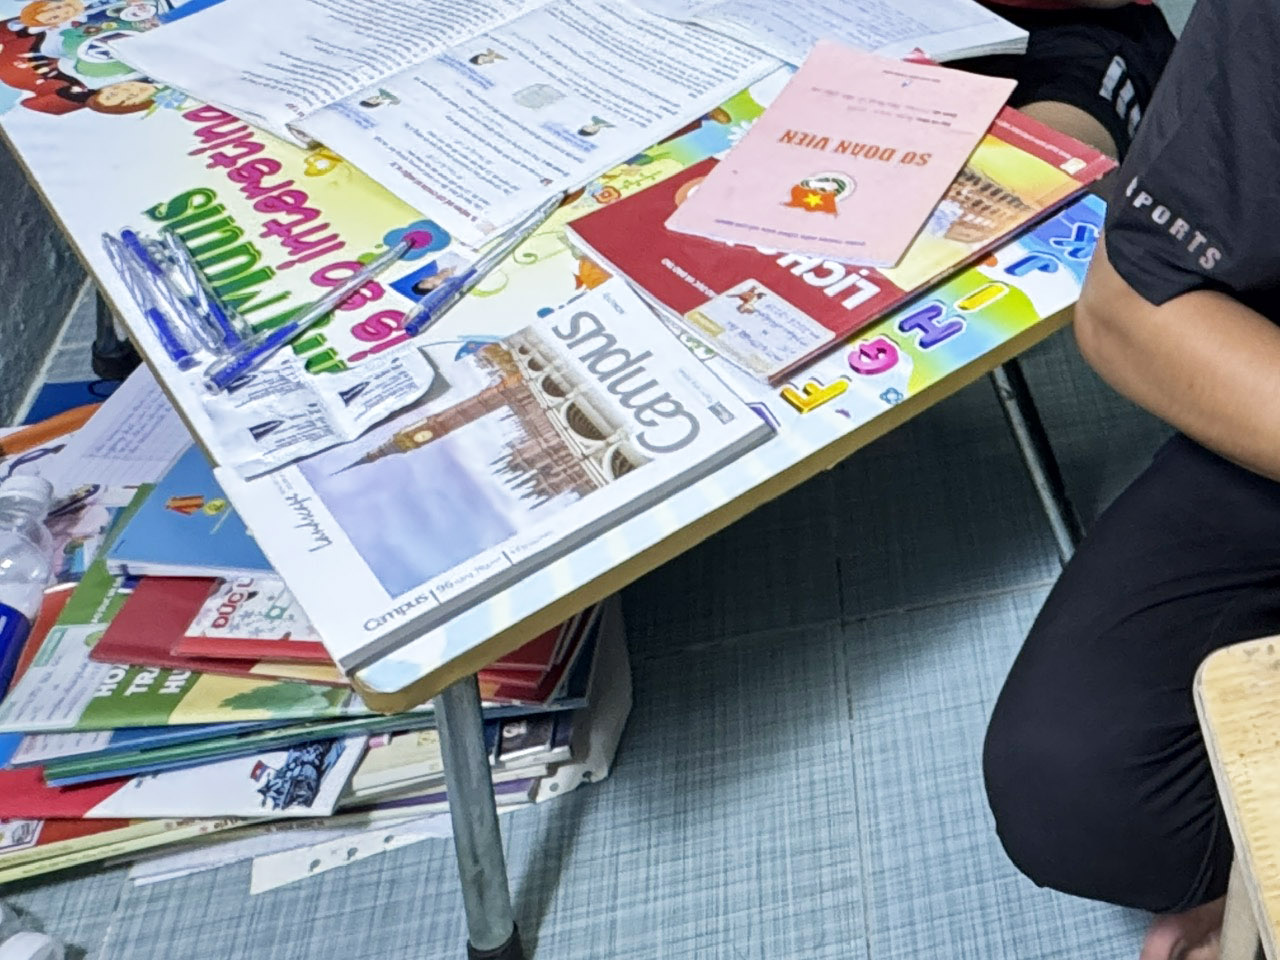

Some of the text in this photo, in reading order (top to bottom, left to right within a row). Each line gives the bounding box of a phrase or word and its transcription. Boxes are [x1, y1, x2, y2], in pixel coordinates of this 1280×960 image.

[551, 310, 701, 453] Campus
[781, 376, 850, 414] F
[848, 335, 900, 375] G
[898, 299, 967, 350] H
[281, 493, 334, 553] Landscape
[363, 592, 429, 632] Campus
